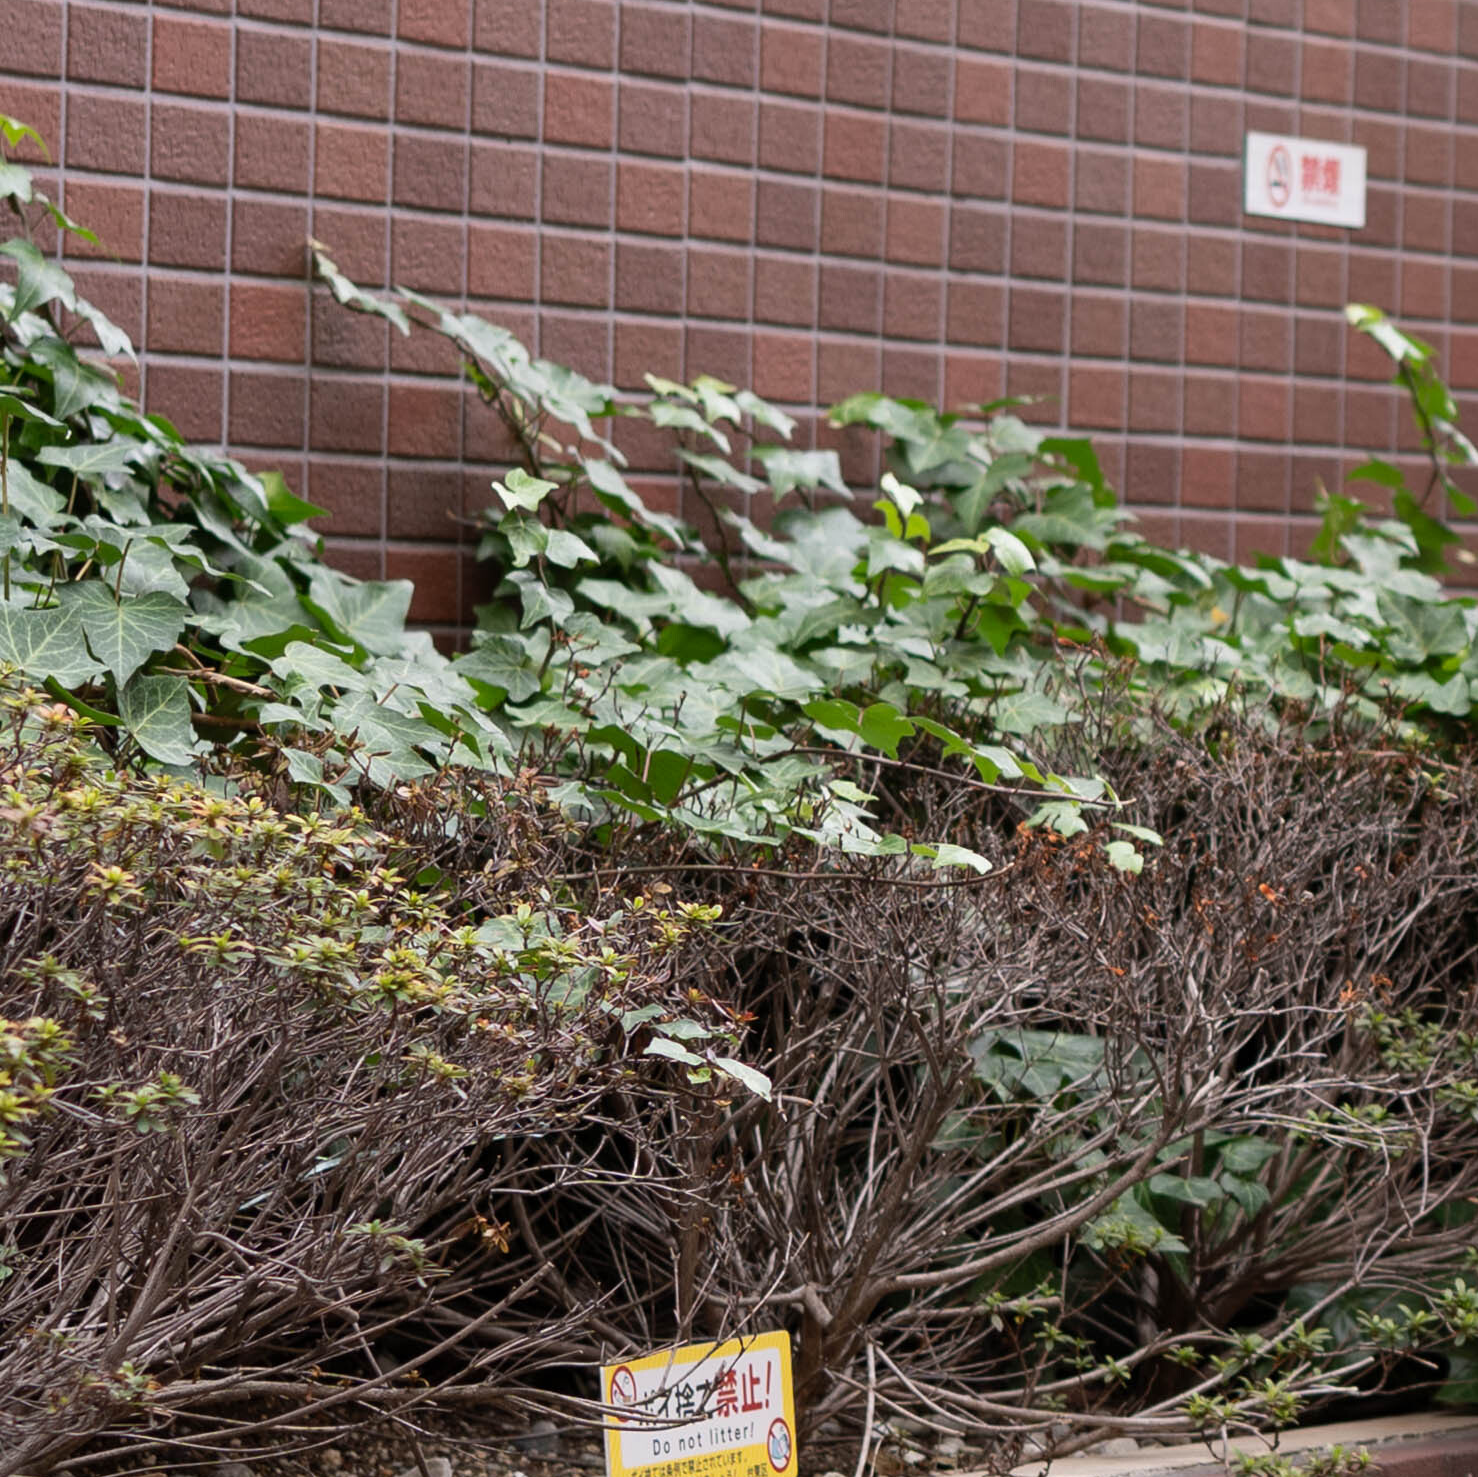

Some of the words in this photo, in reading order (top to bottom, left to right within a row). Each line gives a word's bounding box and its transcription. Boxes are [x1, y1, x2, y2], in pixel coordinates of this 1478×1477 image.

[652, 1439, 671, 1456] Do
[679, 1435, 703, 1451] not
[710, 1422, 755, 1445] litter!
